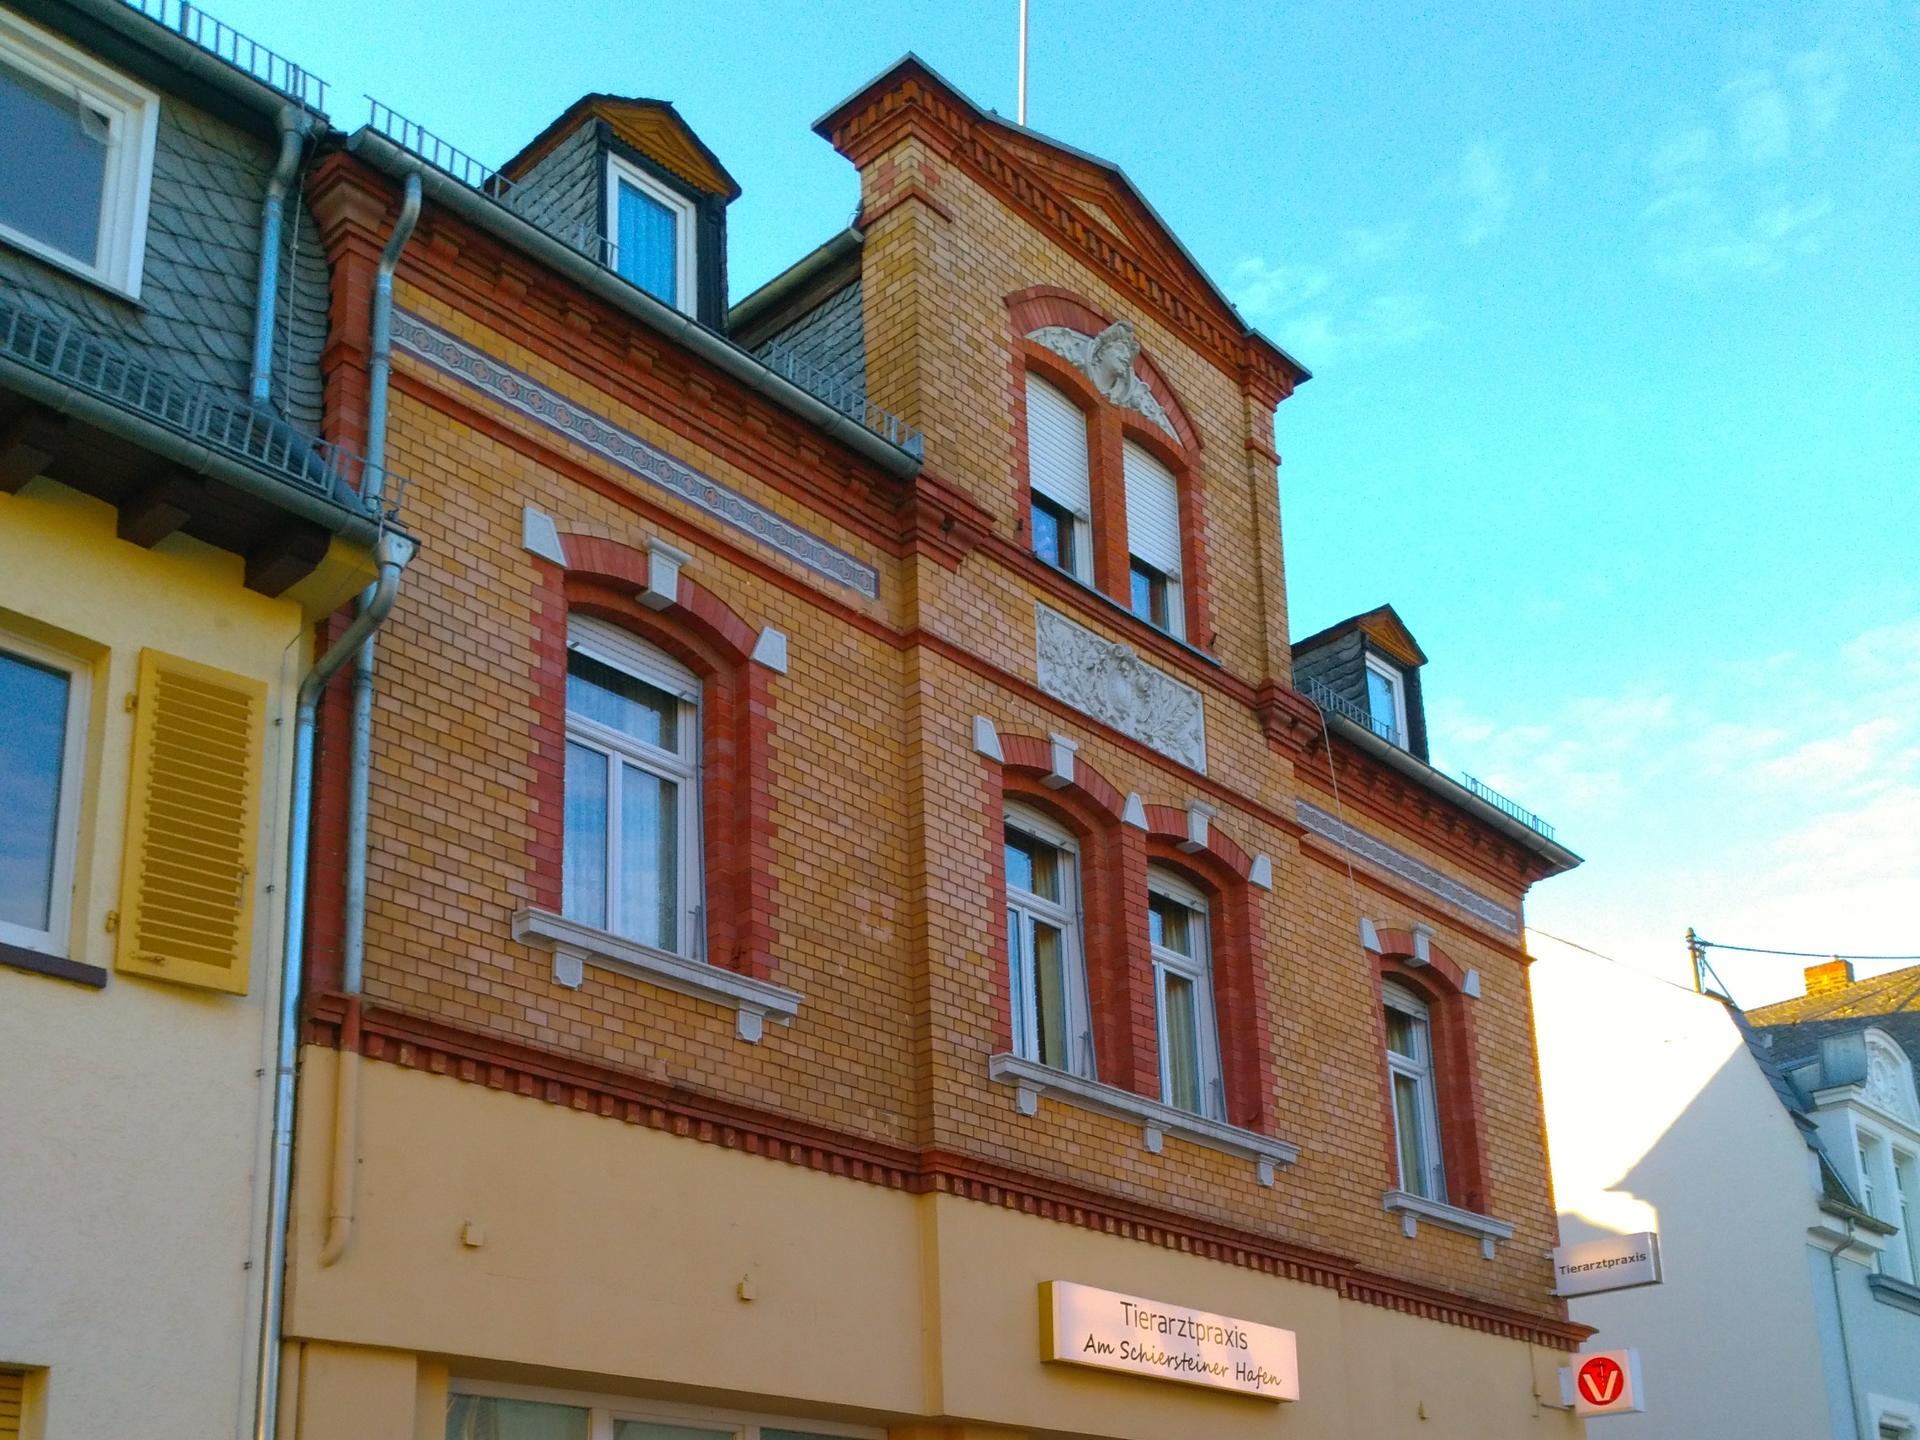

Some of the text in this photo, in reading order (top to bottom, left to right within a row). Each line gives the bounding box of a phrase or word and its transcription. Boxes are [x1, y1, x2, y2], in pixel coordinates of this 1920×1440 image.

[1559, 1252, 1647, 1275] Tierarztpraxis
[1119, 1301, 1249, 1350] Tierarztpraxis
[1083, 1333, 1282, 1389] Am Schiersteiner Hafen
